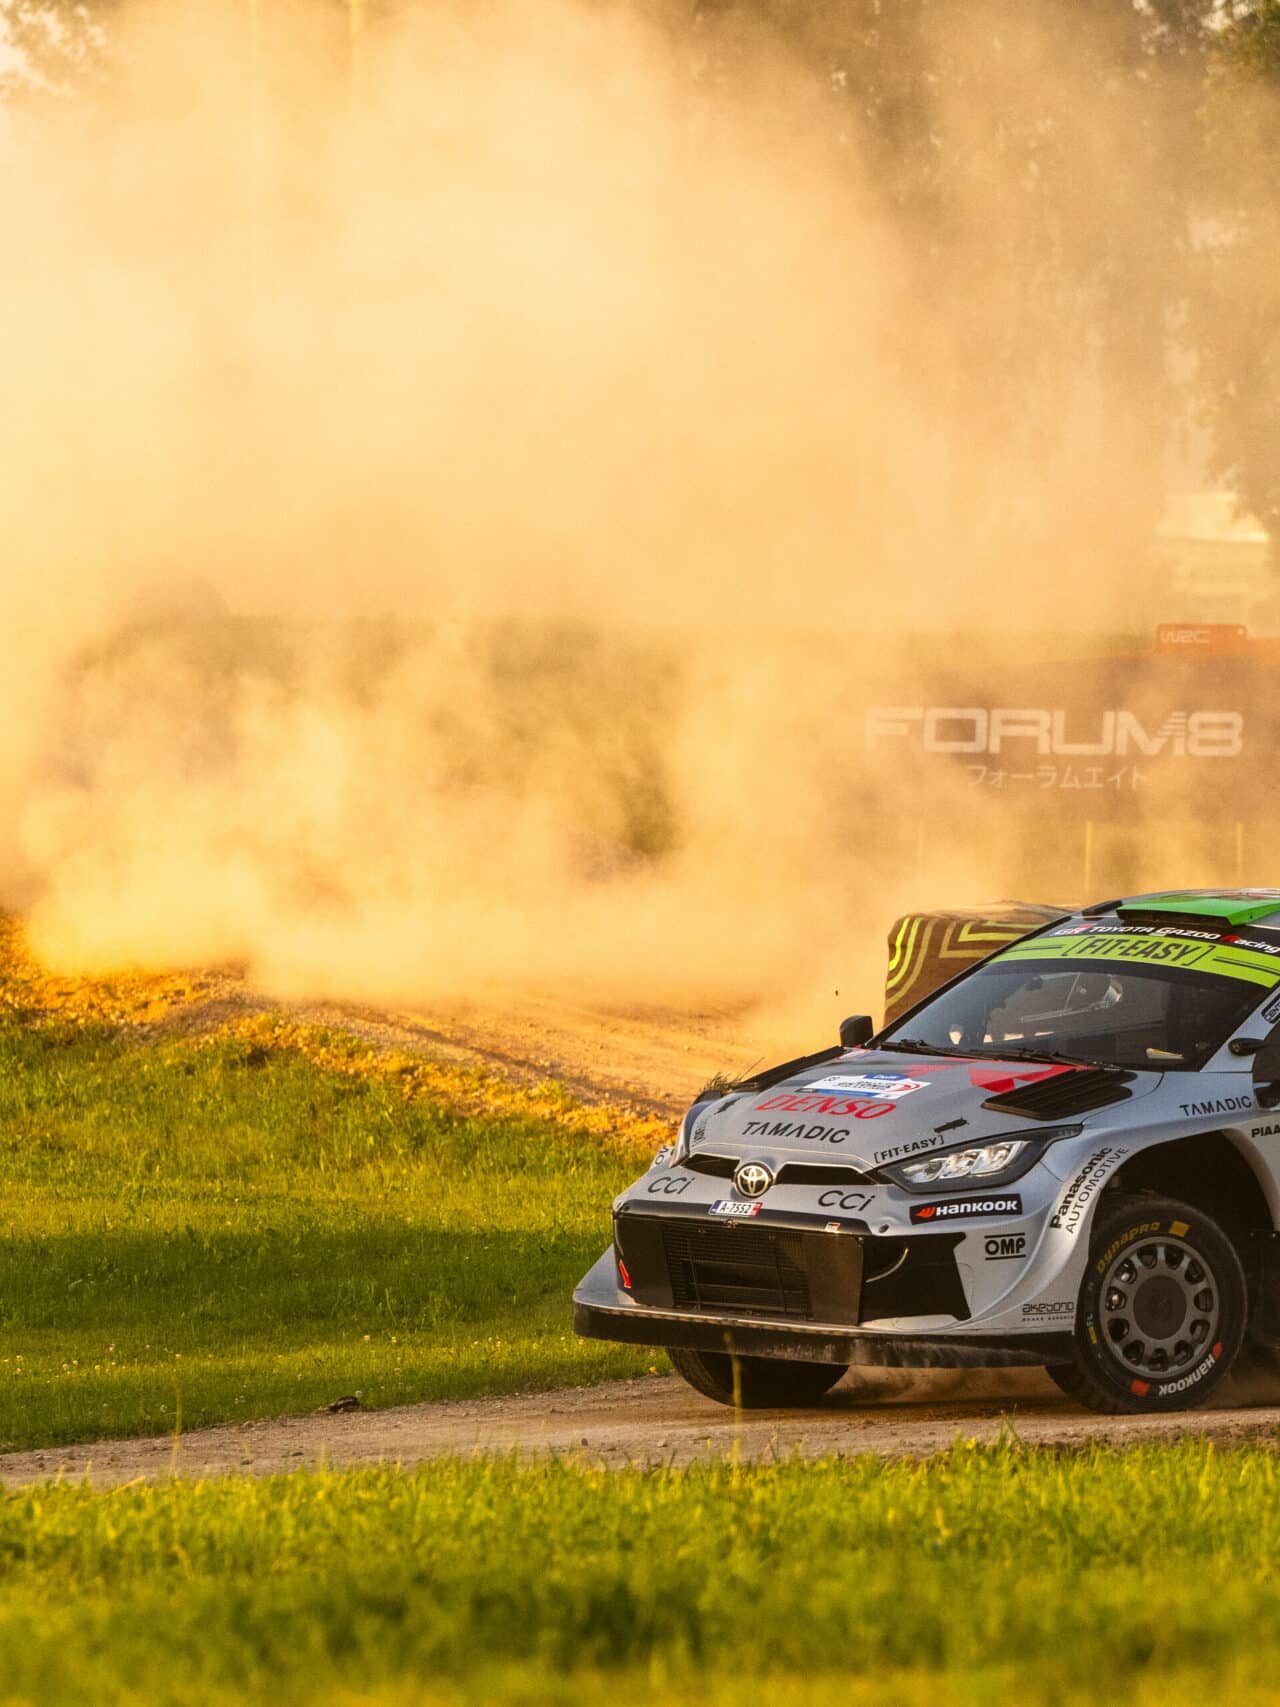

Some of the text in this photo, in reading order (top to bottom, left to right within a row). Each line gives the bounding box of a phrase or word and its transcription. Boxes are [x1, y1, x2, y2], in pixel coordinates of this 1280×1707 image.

[866, 706, 1243, 757] FORUM8
[966, 764, 1148, 789] フォーラムエイト
[1089, 926, 1154, 934] TOYOTA
[1155, 927, 1221, 940] GAZOO
[754, 1093, 897, 1119] DENSO
[1179, 1096, 1252, 1117] TAMADIC
[741, 1121, 851, 1143] TAMADIC
[1049, 1146, 1113, 1229] Panasonic
[1065, 1146, 1129, 1234] AUTOMOTIVE
[985, 1238, 1026, 1255] OMP
